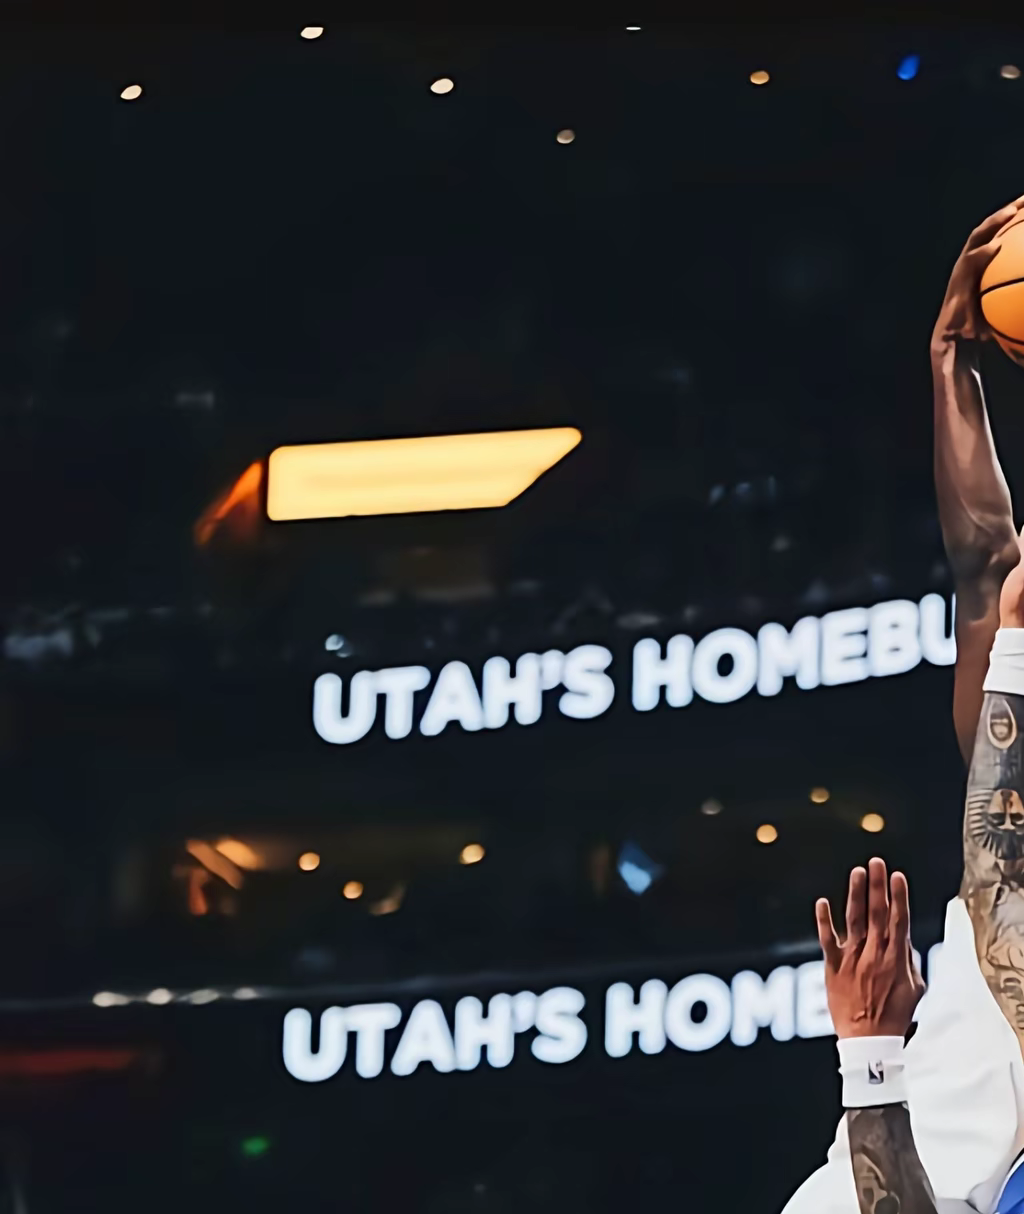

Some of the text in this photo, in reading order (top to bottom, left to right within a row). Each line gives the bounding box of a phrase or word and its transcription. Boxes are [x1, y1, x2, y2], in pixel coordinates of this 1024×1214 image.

[313, 644, 615, 744] UTAH'S
[283, 950, 880, 1082] UTAH'S HOME
